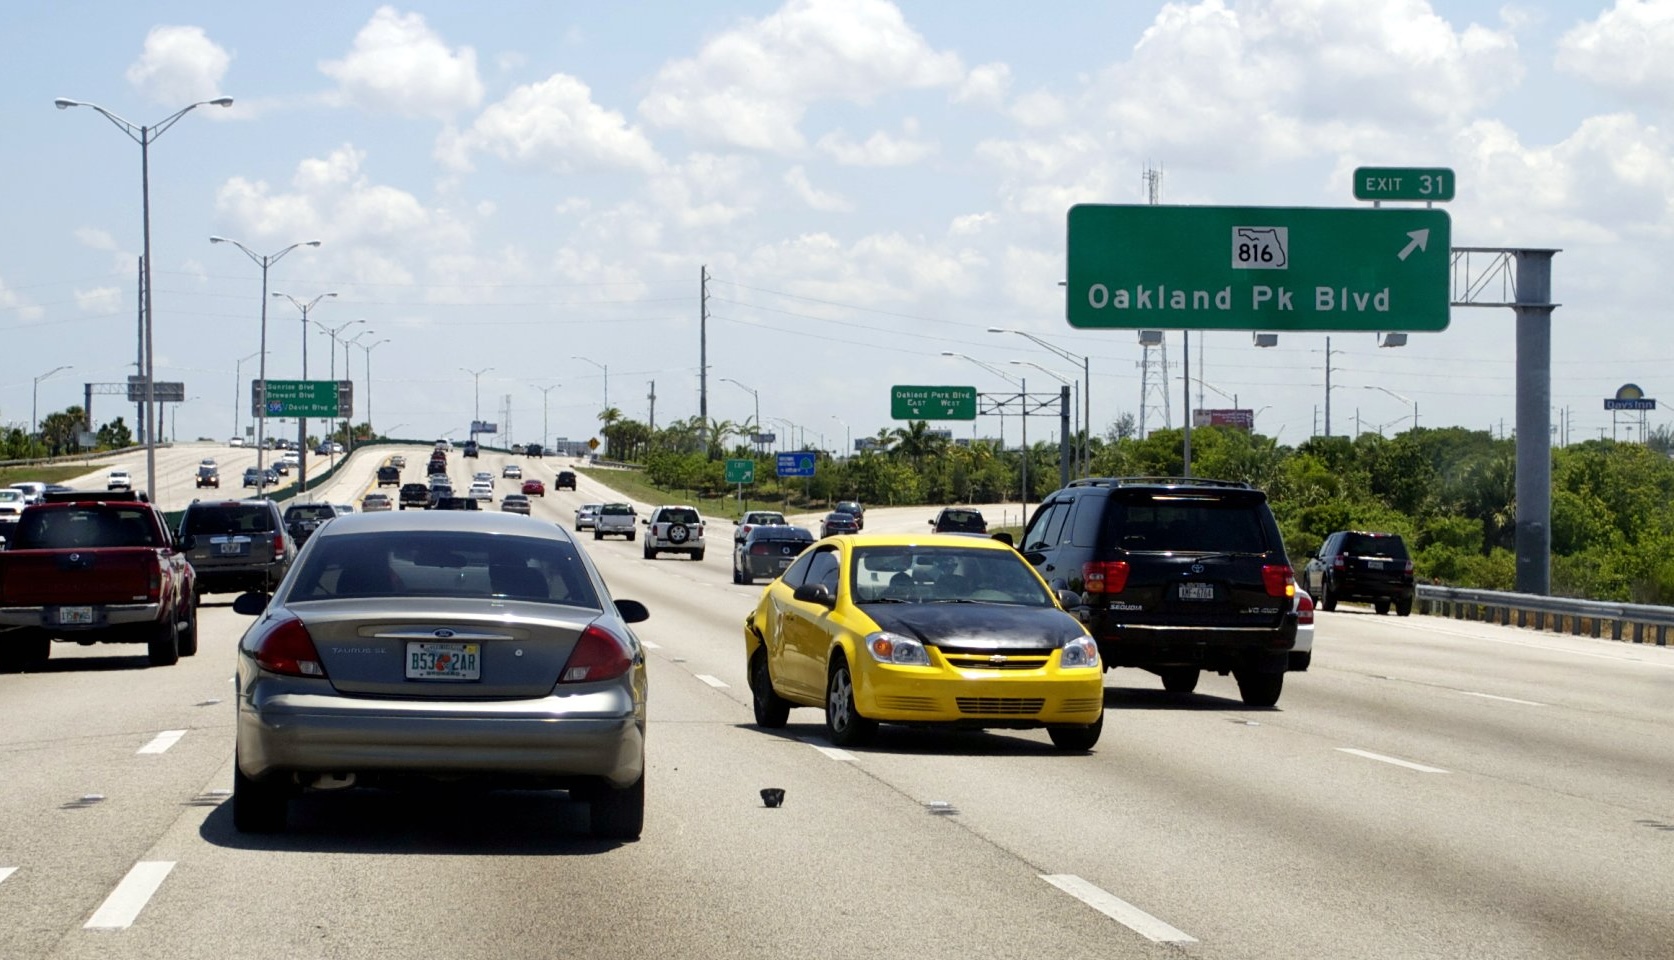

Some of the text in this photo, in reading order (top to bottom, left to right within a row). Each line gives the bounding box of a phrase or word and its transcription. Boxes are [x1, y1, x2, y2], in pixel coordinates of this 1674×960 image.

[1366, 175, 1444, 195] EXIT 31
[1238, 243, 1273, 262] 816
[1087, 283, 1390, 312] Oakland Pk Blvd
[896, 391, 928, 399] Oakland
[931, 391, 950, 399] Park
[1606, 400, 1653, 410] Days Inn
